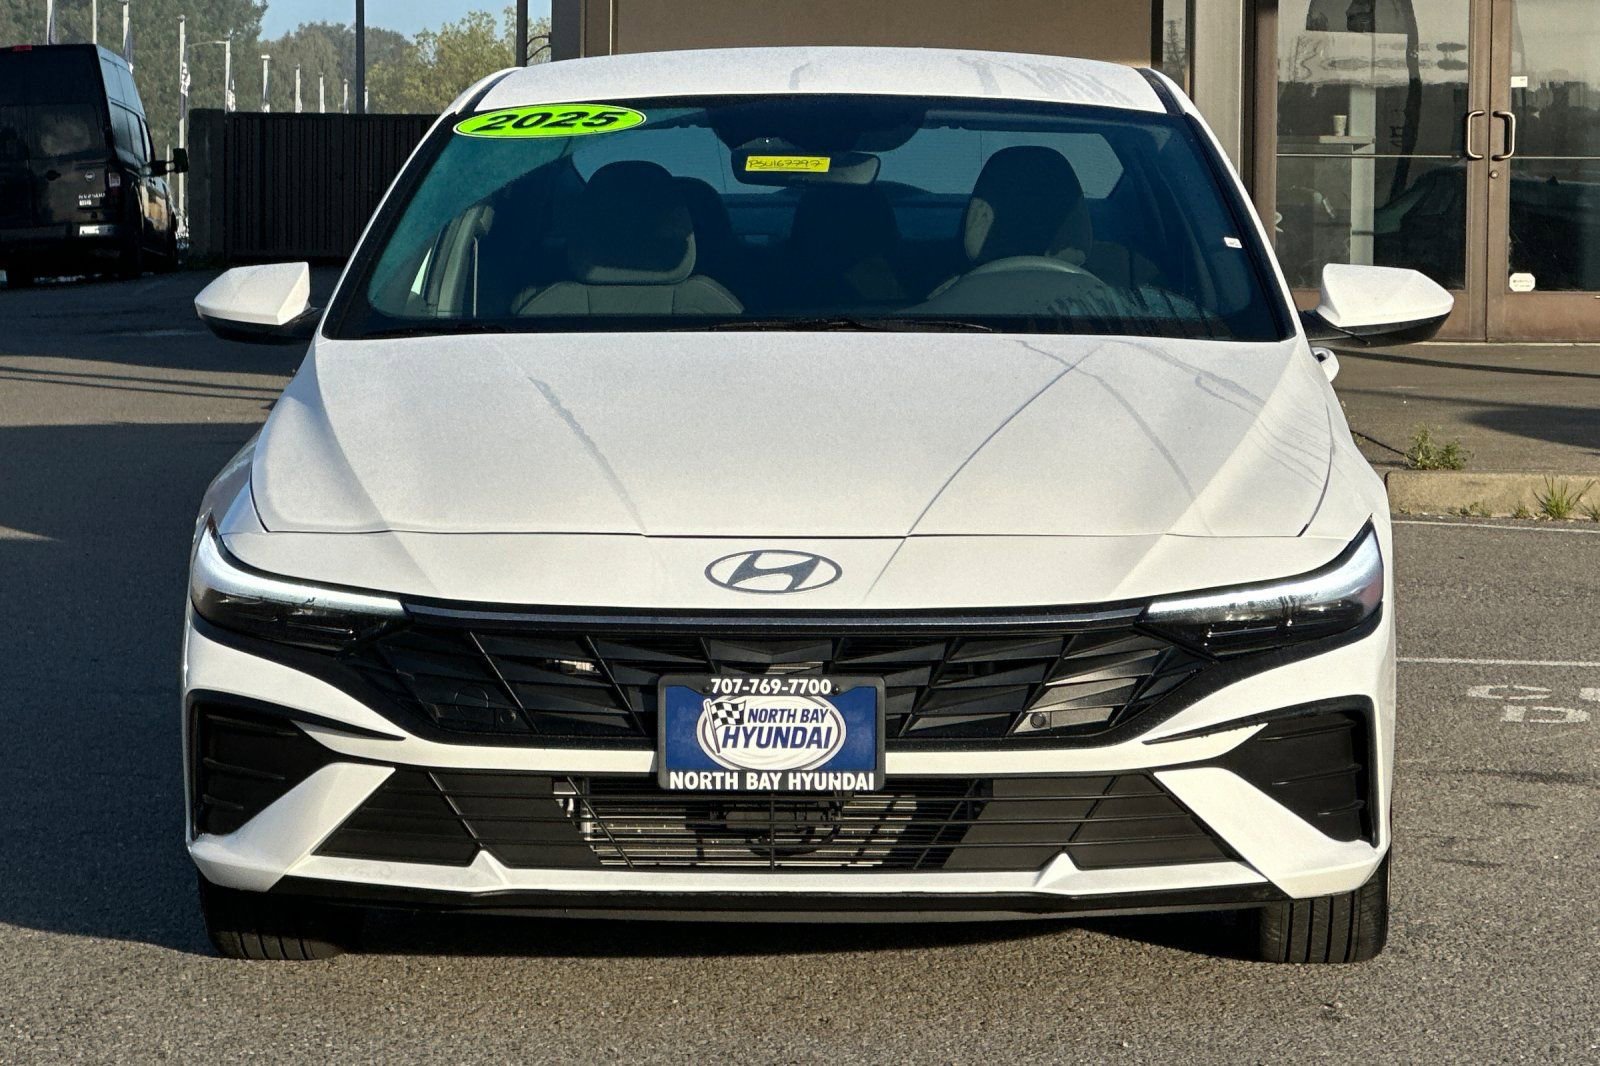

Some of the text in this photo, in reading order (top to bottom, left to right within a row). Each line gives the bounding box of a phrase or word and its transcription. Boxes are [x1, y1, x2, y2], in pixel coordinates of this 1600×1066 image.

[470, 111, 629, 133] 2025
[711, 678, 832, 694] 707-769-7700
[747, 708, 829, 723] NORTH BAY
[721, 726, 833, 749] HYUNDAI
[669, 771, 874, 791] NORTH BAY HYUNDAI
